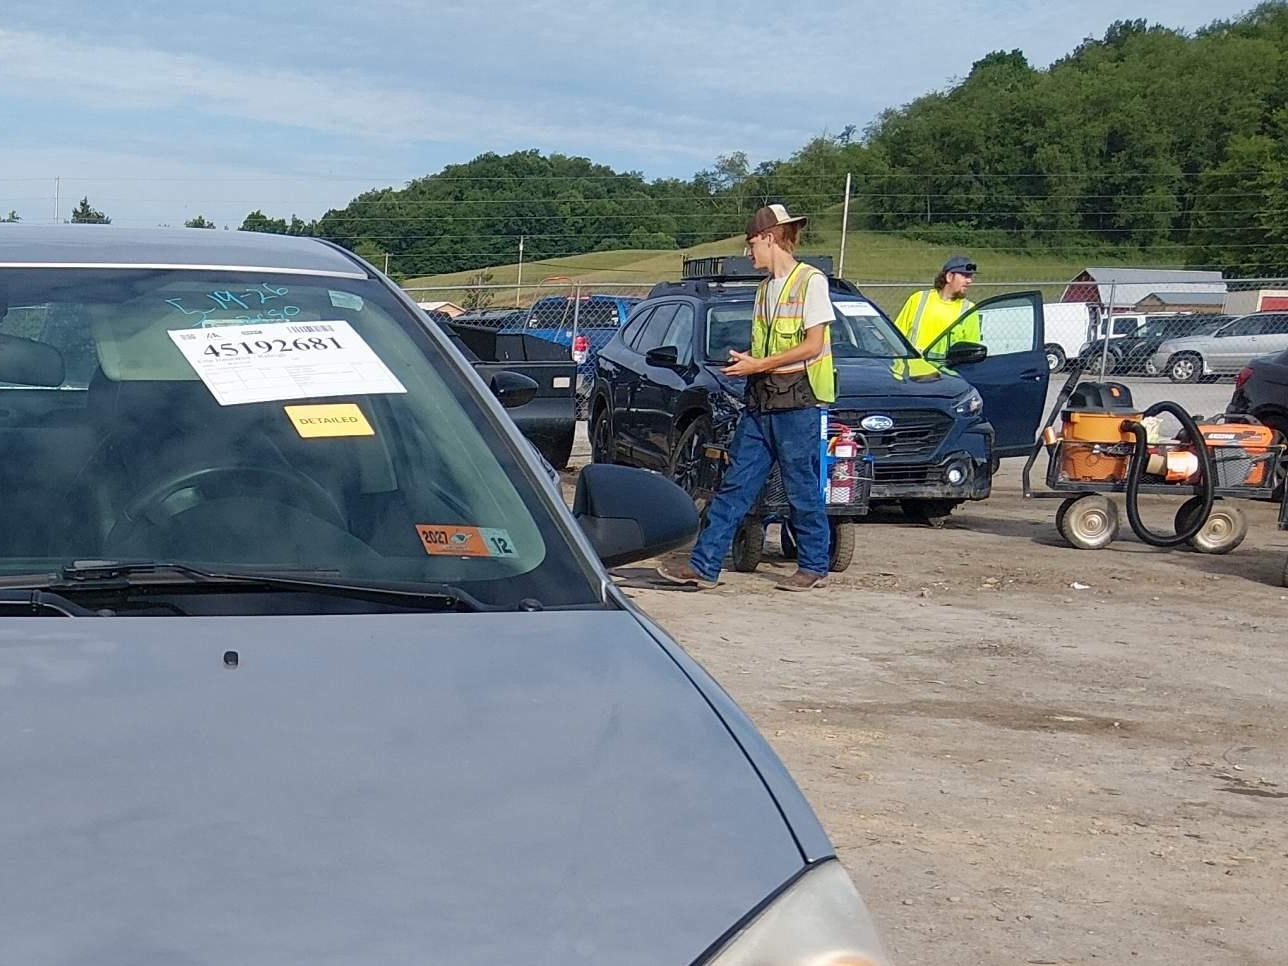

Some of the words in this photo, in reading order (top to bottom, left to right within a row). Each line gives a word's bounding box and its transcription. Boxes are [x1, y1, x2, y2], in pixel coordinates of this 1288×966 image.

[203, 336, 344, 358] 45192681
[298, 416, 358, 425] DETAILED
[421, 530, 449, 545] 2027
[490, 537, 512, 554] 12
